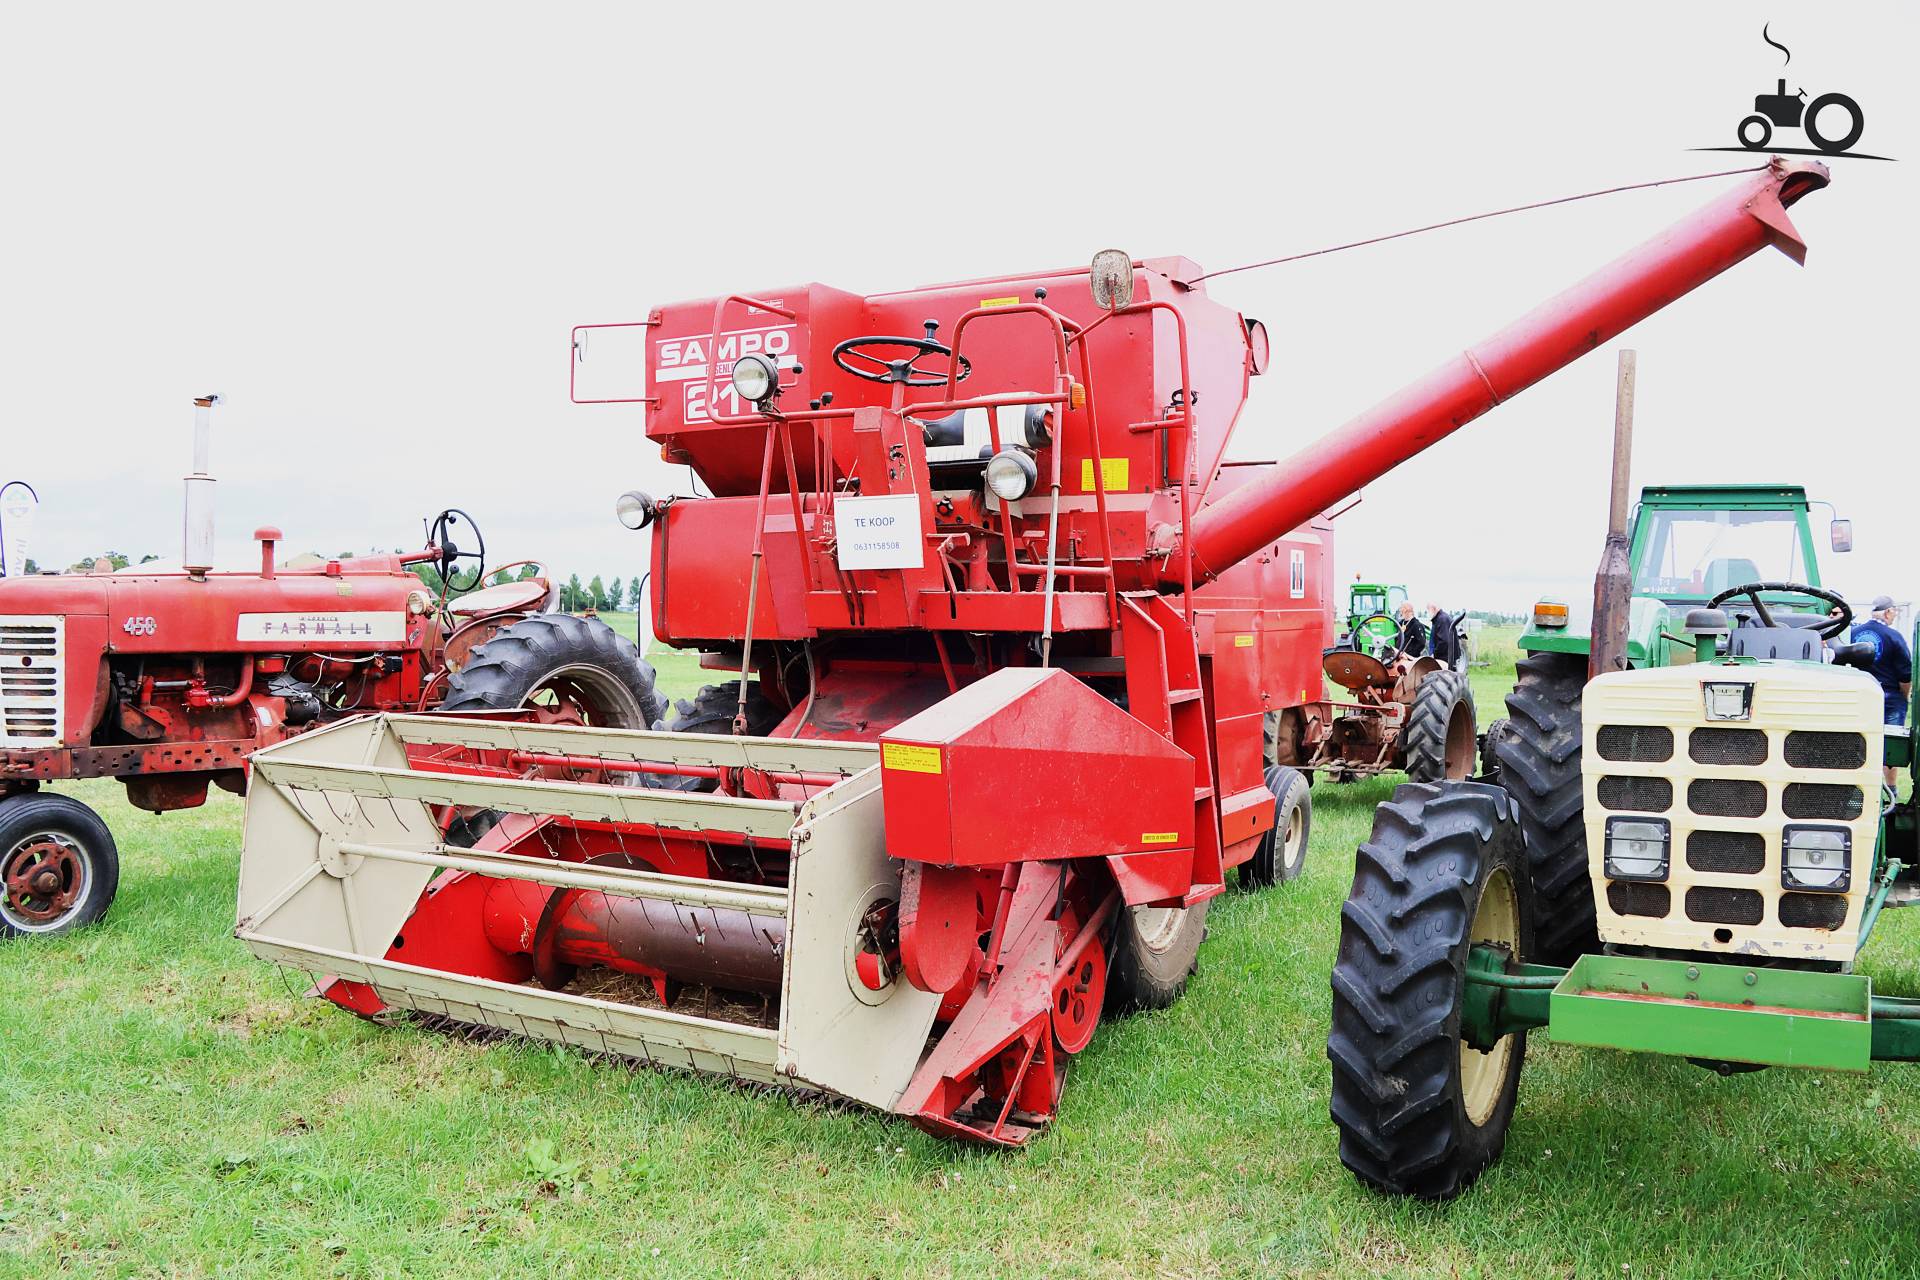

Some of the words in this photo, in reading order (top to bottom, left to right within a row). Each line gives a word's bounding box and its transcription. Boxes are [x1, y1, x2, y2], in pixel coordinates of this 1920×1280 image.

[660, 330, 789, 367] SAMPO
[687, 383, 761, 419] 21
[854, 518, 866, 527] TE
[869, 516, 895, 527] KOOP
[264, 622, 372, 635] FARMALL
